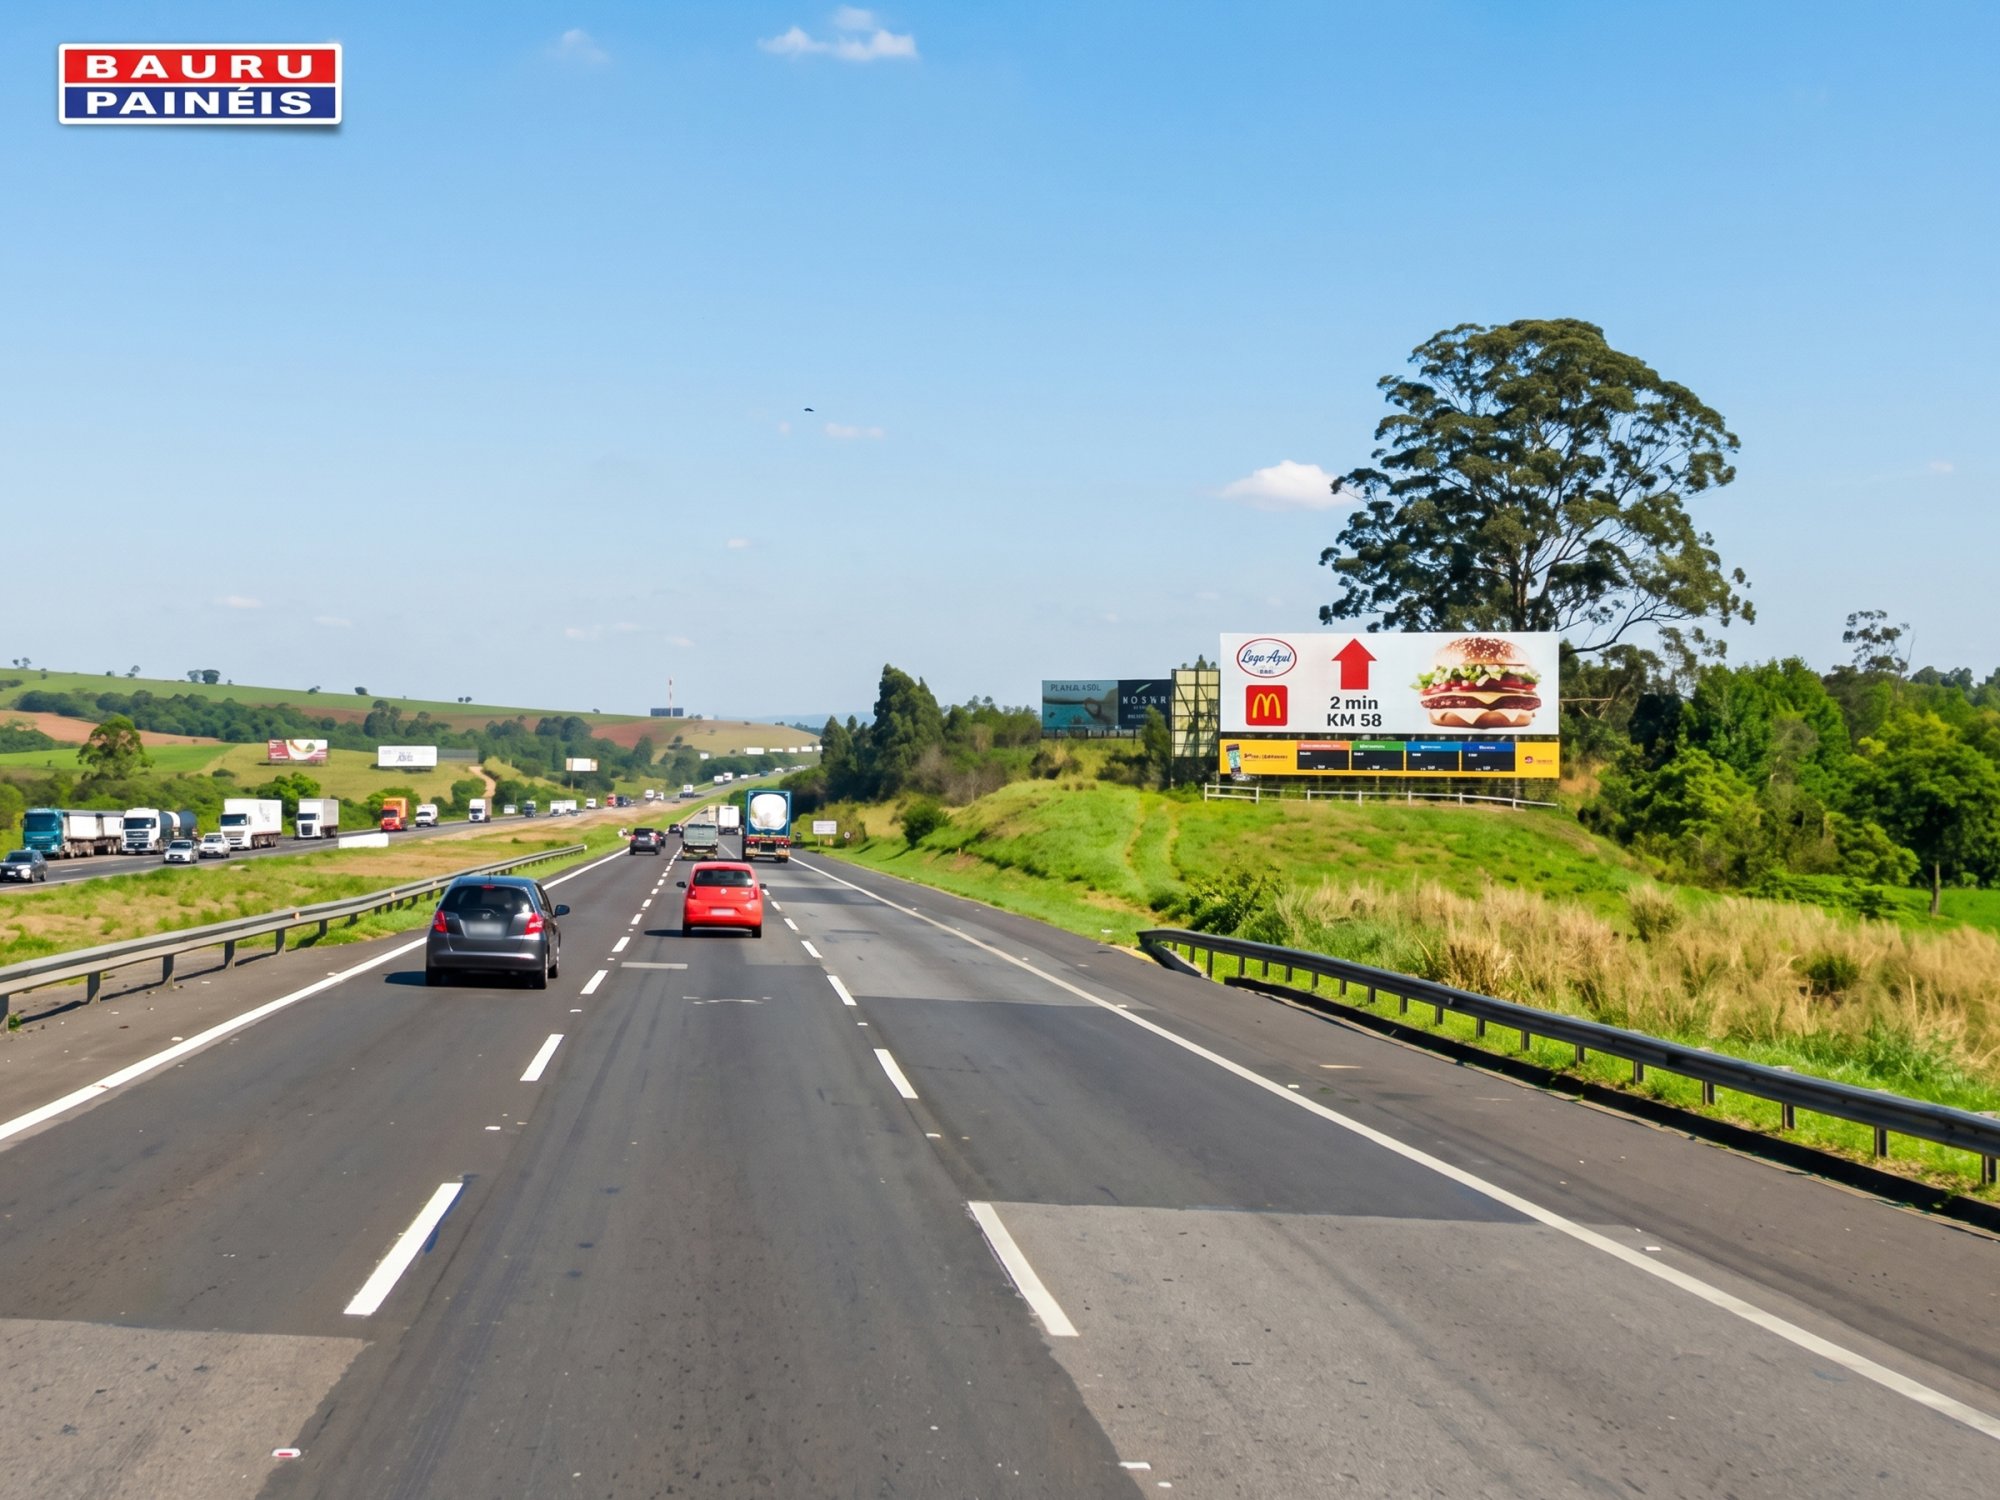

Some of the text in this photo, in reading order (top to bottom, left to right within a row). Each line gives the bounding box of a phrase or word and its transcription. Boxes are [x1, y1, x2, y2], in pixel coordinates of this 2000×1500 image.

[1266, 649, 1292, 666] Azul
[1330, 695, 1378, 710] 2 min
[1327, 713, 1382, 727] KM 58
